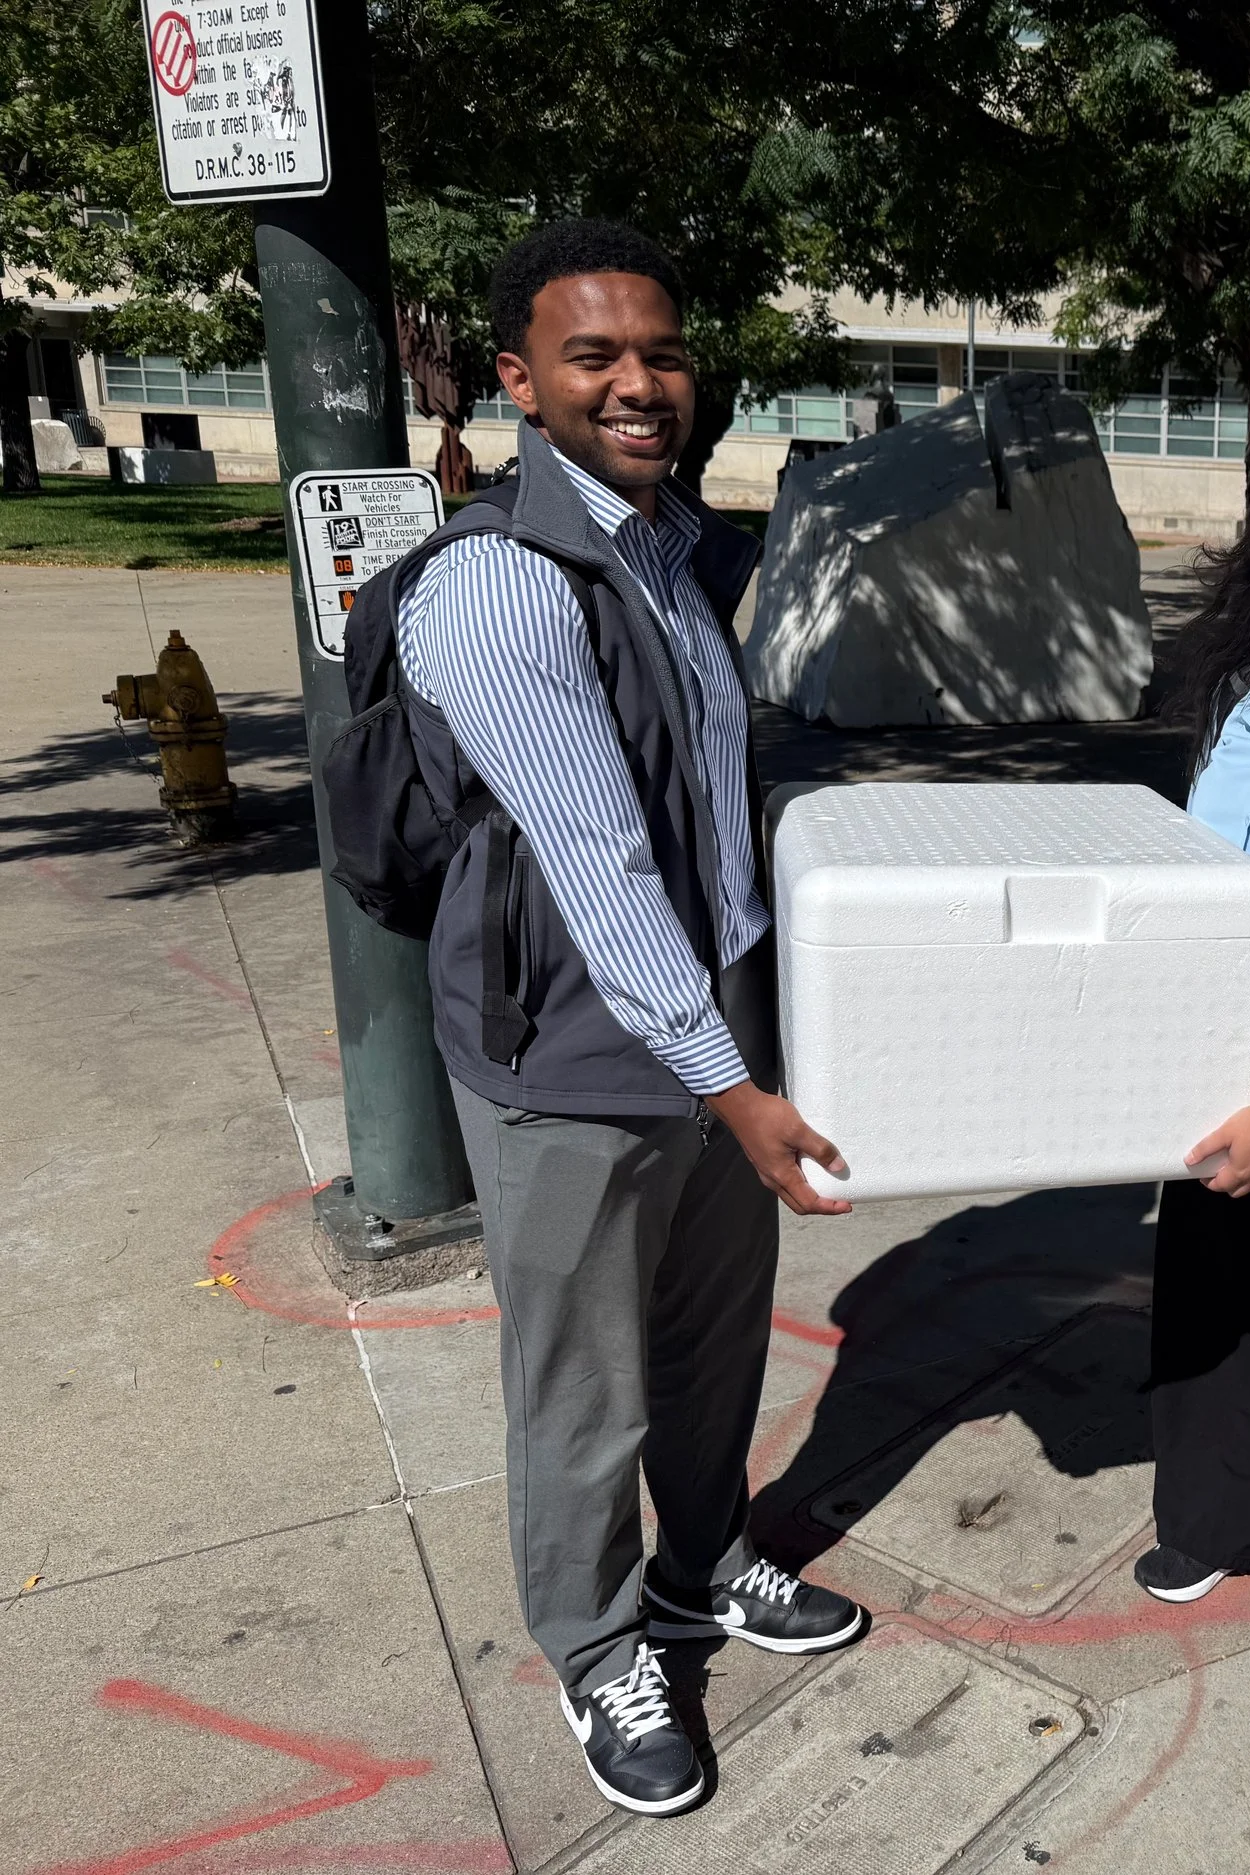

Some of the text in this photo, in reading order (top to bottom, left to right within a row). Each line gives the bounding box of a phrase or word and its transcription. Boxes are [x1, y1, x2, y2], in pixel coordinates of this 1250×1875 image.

[197, 9, 233, 29] 7:30AM
[241, 5, 269, 25] Except
[277, 2, 286, 17] to
[217, 30, 244, 56] official
[246, 28, 283, 52] business
[223, 60, 236, 81] the
[184, 91, 219, 113] Violators
[226, 91, 239, 108] are
[172, 116, 203, 141] citation
[207, 120, 215, 137] or
[221, 111, 248, 135] arrest
[296, 105, 307, 128] to
[195, 150, 296, 181] D.R.M.C. 38-115
[341, 479, 415, 492] START CROSSING
[360, 492, 402, 503] Watch For
[364, 503, 401, 513] Vehicles
[365, 514, 420, 528] DON'T START
[361, 529, 388, 539] Finish
[390, 527, 428, 538] Crossing
[375, 537, 417, 549] If Started
[362, 555, 384, 565] TIME
[361, 566, 371, 576] To
